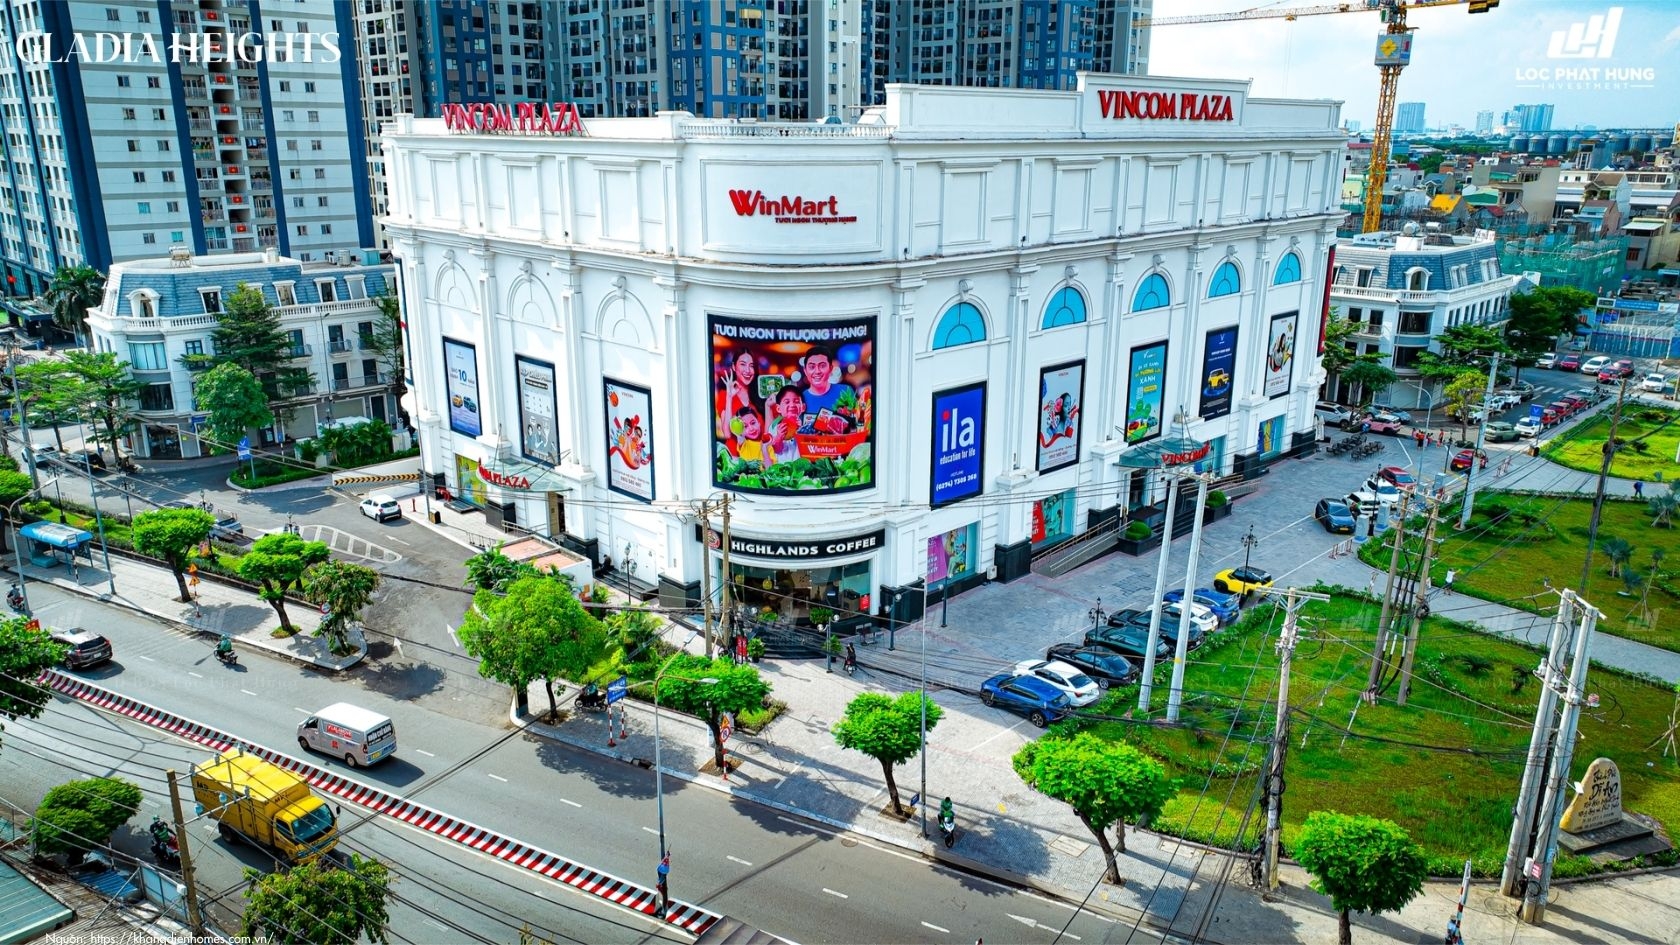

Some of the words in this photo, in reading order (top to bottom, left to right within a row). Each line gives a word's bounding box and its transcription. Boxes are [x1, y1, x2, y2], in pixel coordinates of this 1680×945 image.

[1097, 90, 1177, 119] VINCOM
[1180, 93, 1233, 121] PLAZA
[440, 102, 514, 132] VINCOM
[517, 102, 583, 132] PLAZA
[728, 189, 838, 216] WinMart
[739, 326, 775, 341] NGON
[832, 325, 868, 341] HẠNG!
[458, 369, 467, 382] 10
[942, 408, 975, 453] ila
[807, 444, 837, 454] WinMart
[939, 452, 961, 465] education
[968, 447, 976, 457] life
[731, 541, 819, 556] HIGHLANDS
[826, 536, 877, 554] COFFEE
